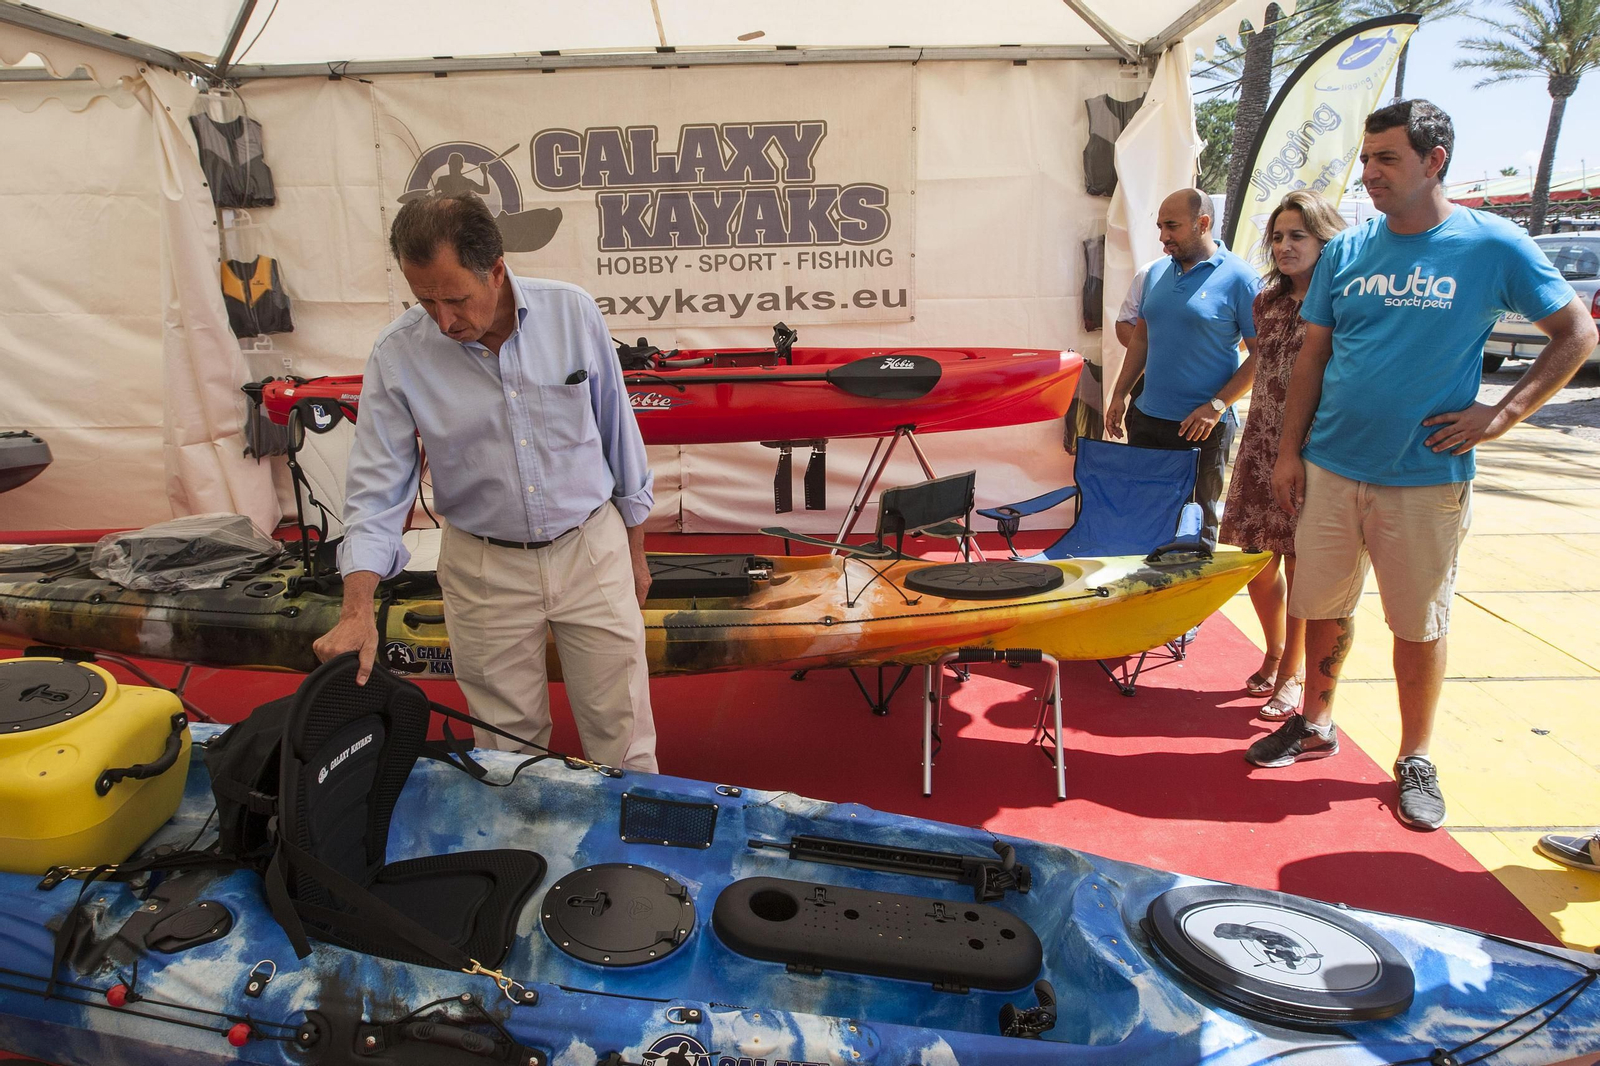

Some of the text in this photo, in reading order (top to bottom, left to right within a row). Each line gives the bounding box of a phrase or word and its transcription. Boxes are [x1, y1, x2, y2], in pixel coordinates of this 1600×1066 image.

[530, 120, 828, 192] GALAXY
[1249, 102, 1342, 202] Jigging
[1310, 146, 1359, 194] arta.com
[595, 182, 892, 252] KAYAKS
[597, 255, 679, 275] HOBBY
[698, 252, 777, 273] SPORT
[797, 248, 894, 270] FISHING
[598, 285, 907, 321] axykayaks.eu
[1384, 296, 1452, 310] sancti petri
[880, 357, 915, 370] Hobie
[416, 646, 453, 660] GALA
[429, 660, 454, 674] KAY
[330, 733, 373, 771] GALAXY KAYAKS
